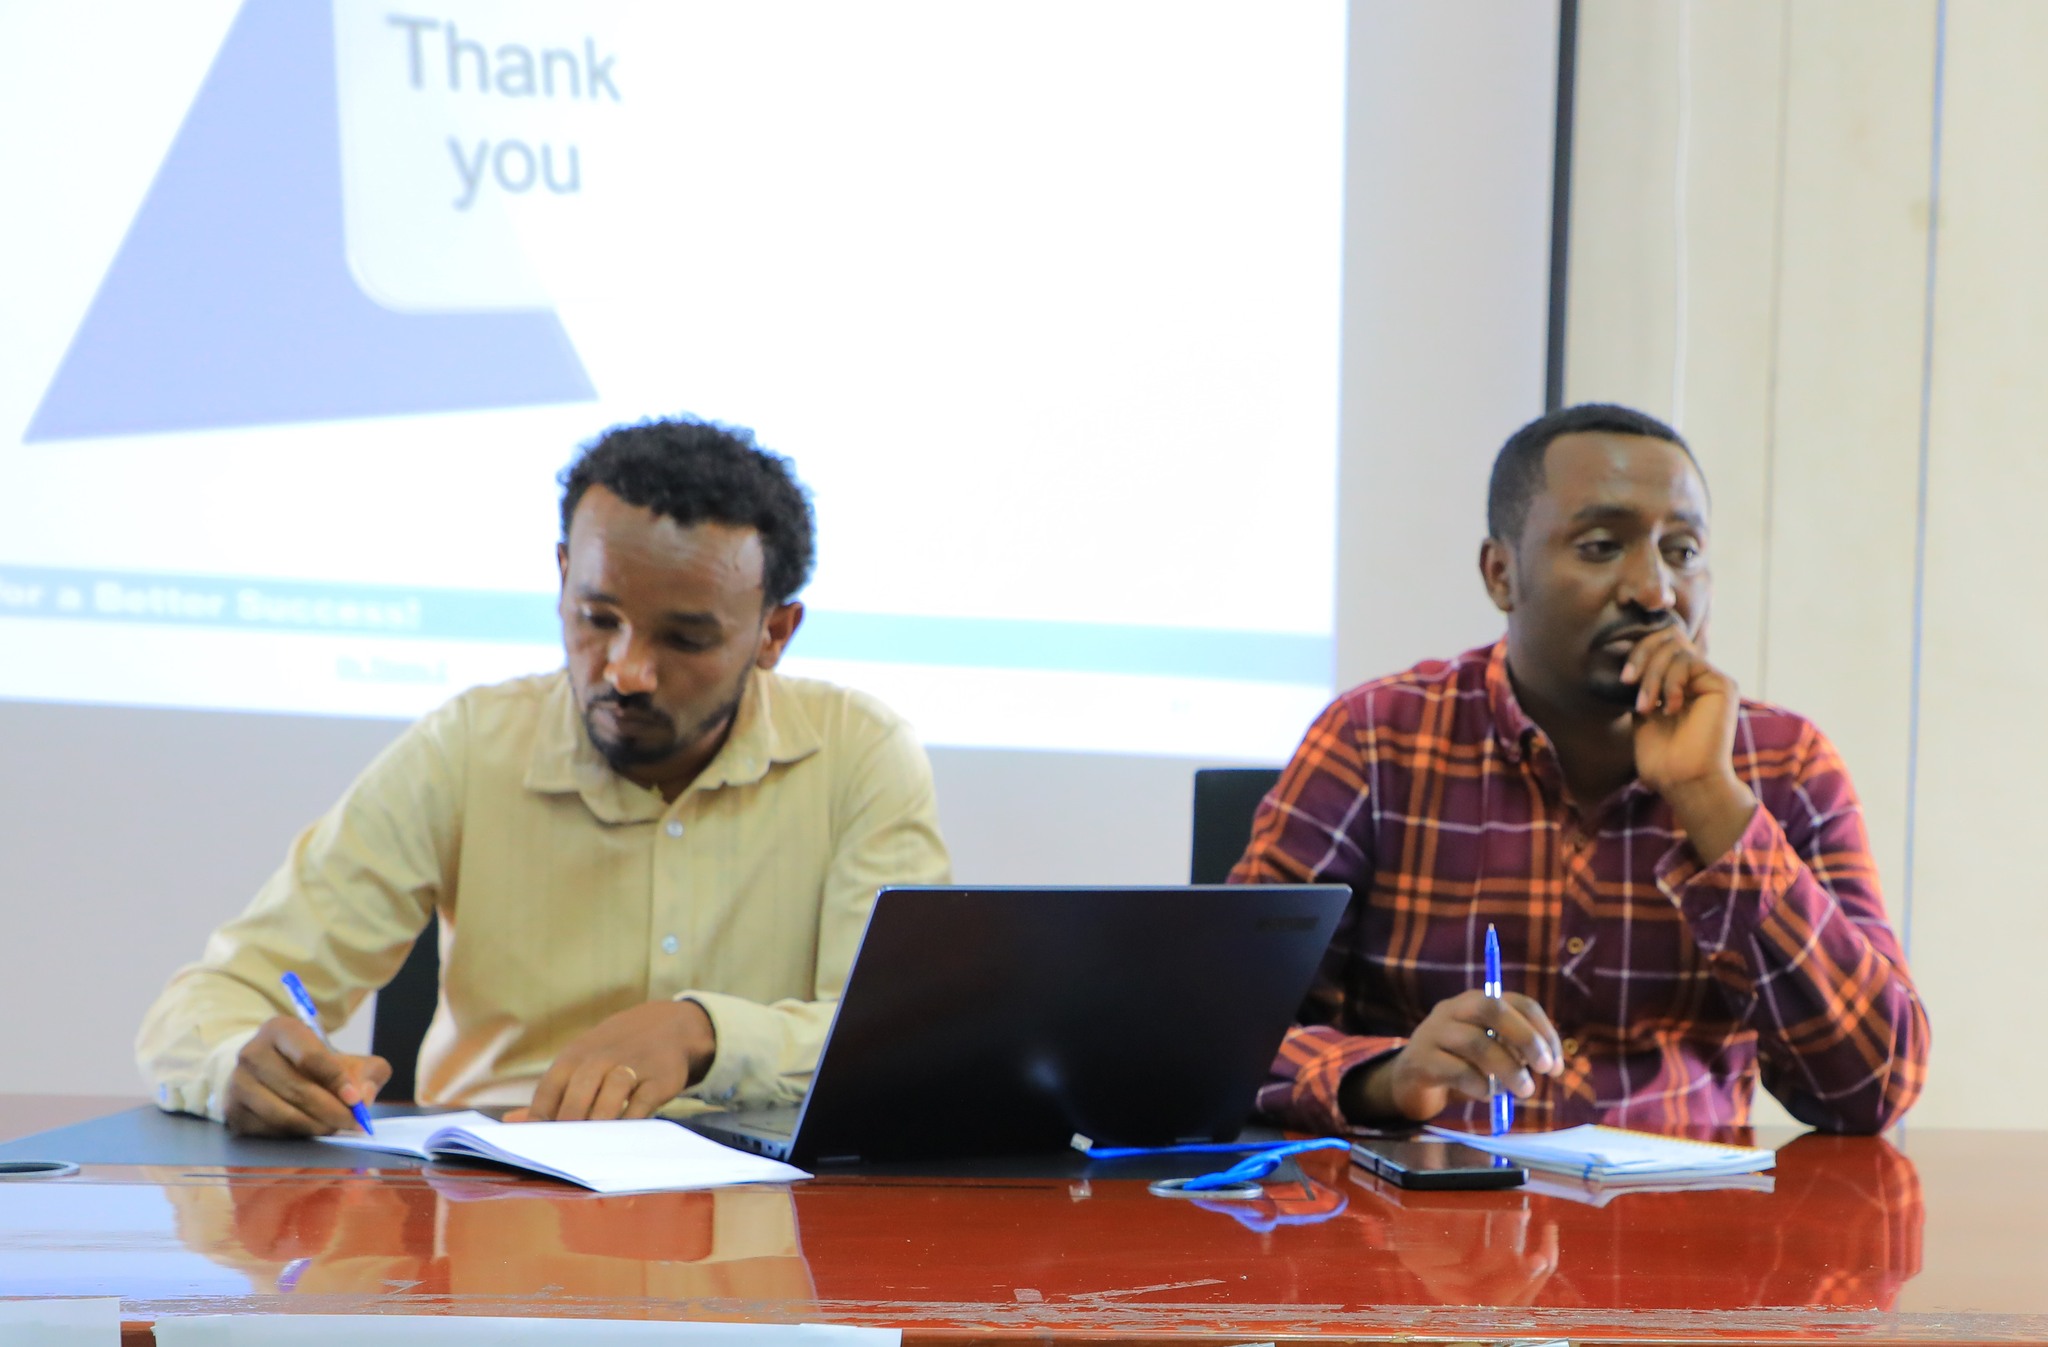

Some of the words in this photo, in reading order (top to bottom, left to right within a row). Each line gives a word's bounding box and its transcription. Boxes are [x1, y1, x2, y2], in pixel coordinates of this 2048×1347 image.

[386, 12, 621, 102] Thank
[447, 136, 580, 211] you
[57, 587, 82, 610] a
[95, 581, 225, 617] Better
[236, 588, 421, 630] Success!
